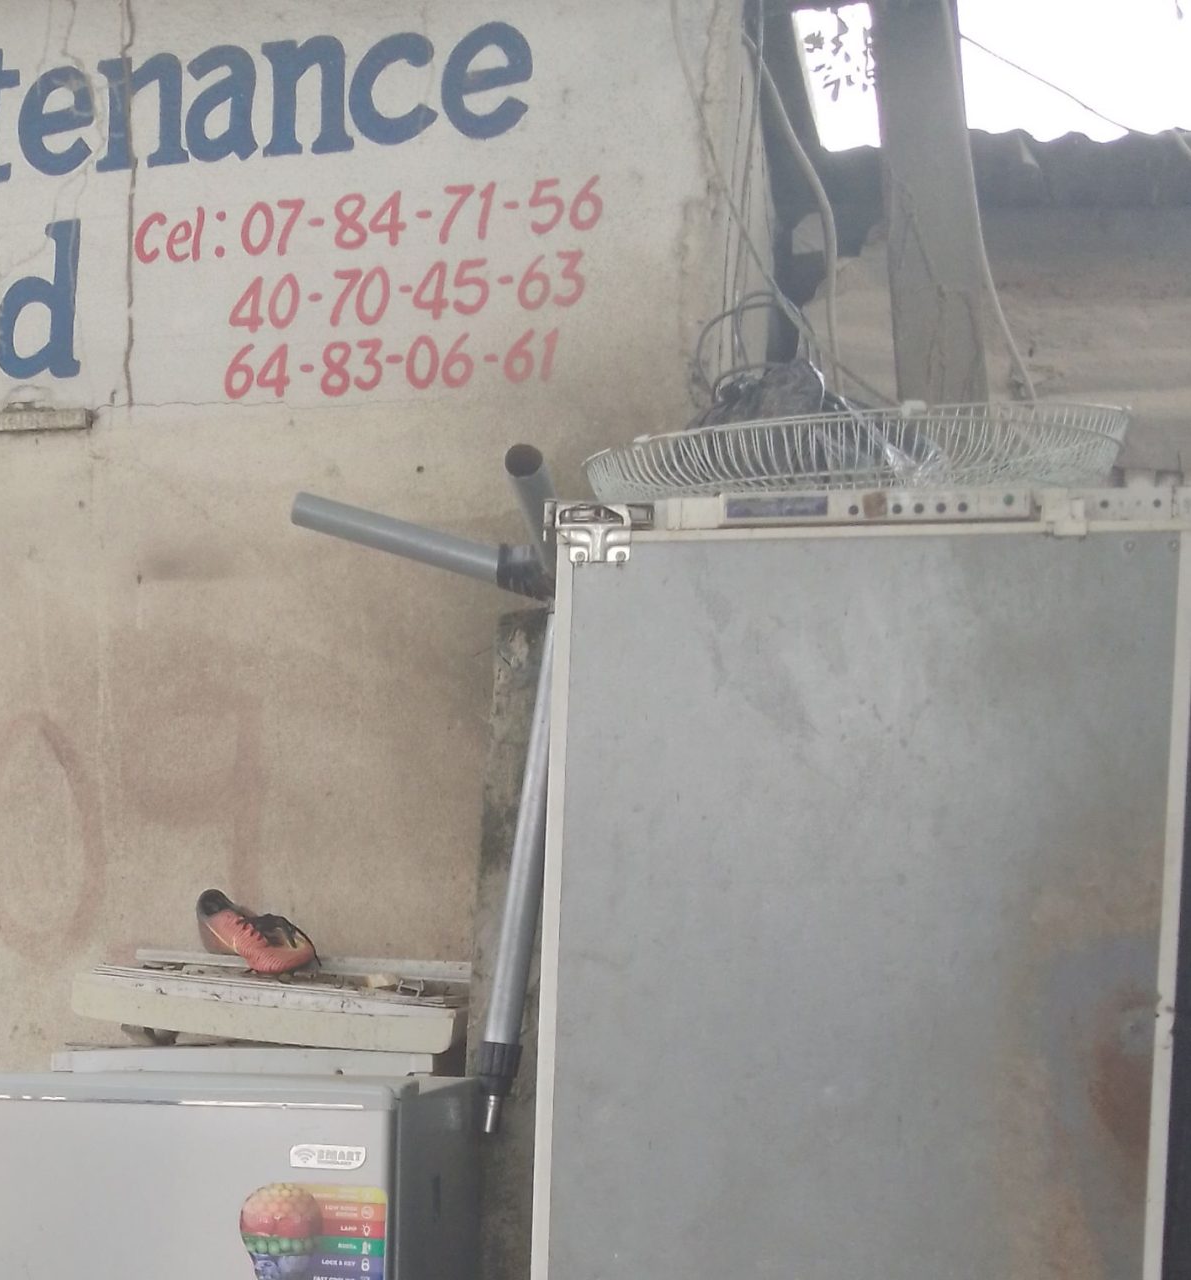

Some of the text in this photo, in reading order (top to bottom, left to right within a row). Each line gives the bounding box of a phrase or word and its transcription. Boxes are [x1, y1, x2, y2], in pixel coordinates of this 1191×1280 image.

[240, 175, 604, 258] 07-84-71-56
[228, 249, 587, 334] 40-70-45-63
[223, 329, 557, 400] 64-83-06-61
